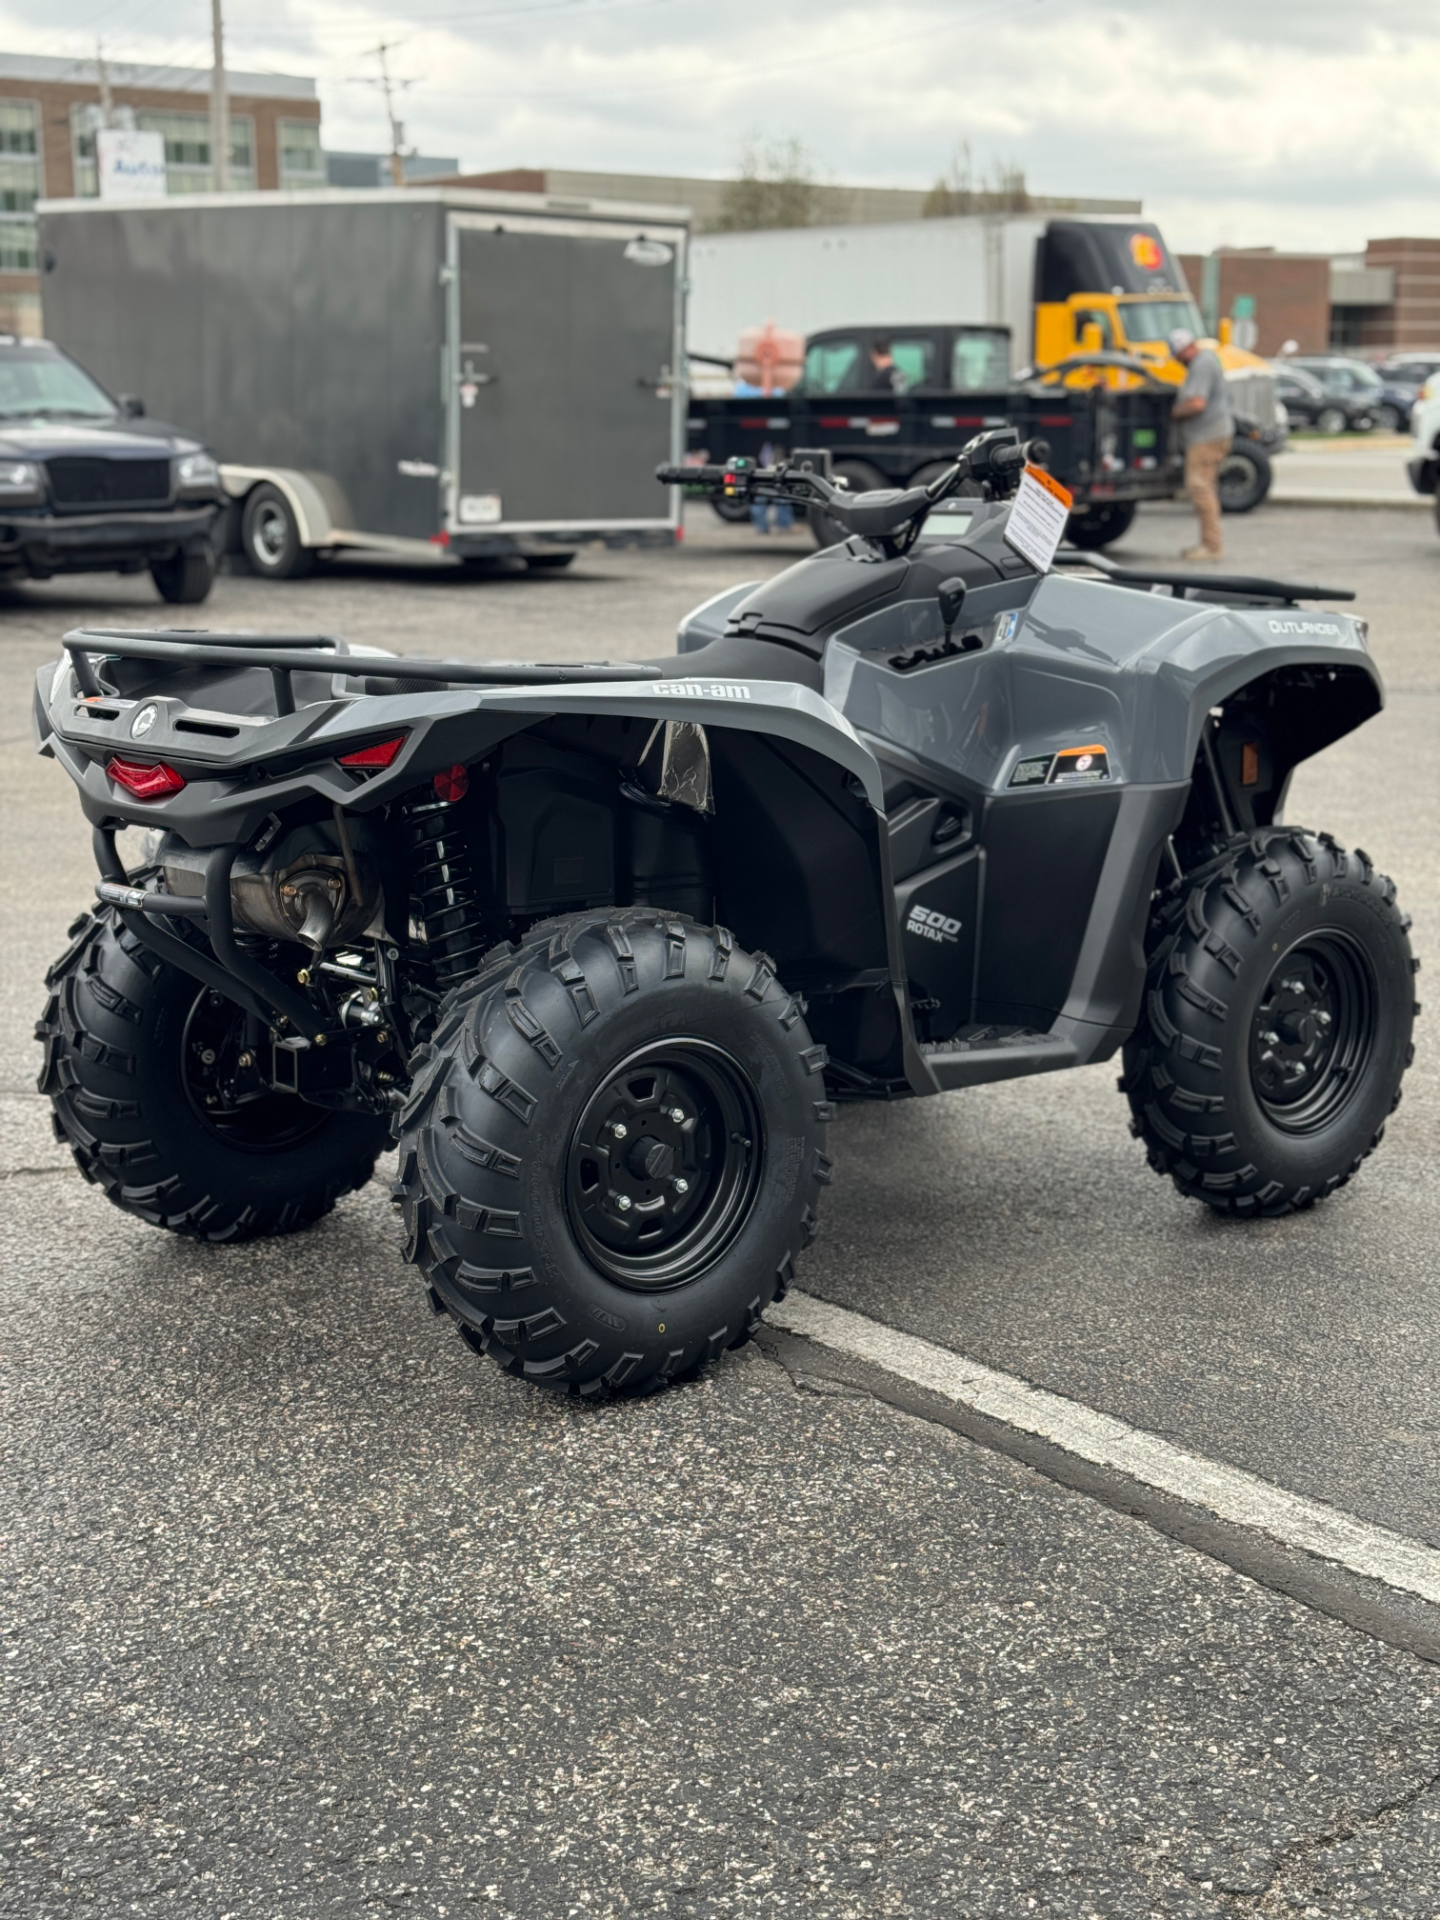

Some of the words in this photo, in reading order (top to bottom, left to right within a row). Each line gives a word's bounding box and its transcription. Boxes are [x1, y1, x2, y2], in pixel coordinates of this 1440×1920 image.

[1268, 619, 1340, 636] OUTLANDER
[652, 683, 751, 699] can-am
[909, 904, 962, 935] 500
[906, 919, 944, 943] ROTAX
